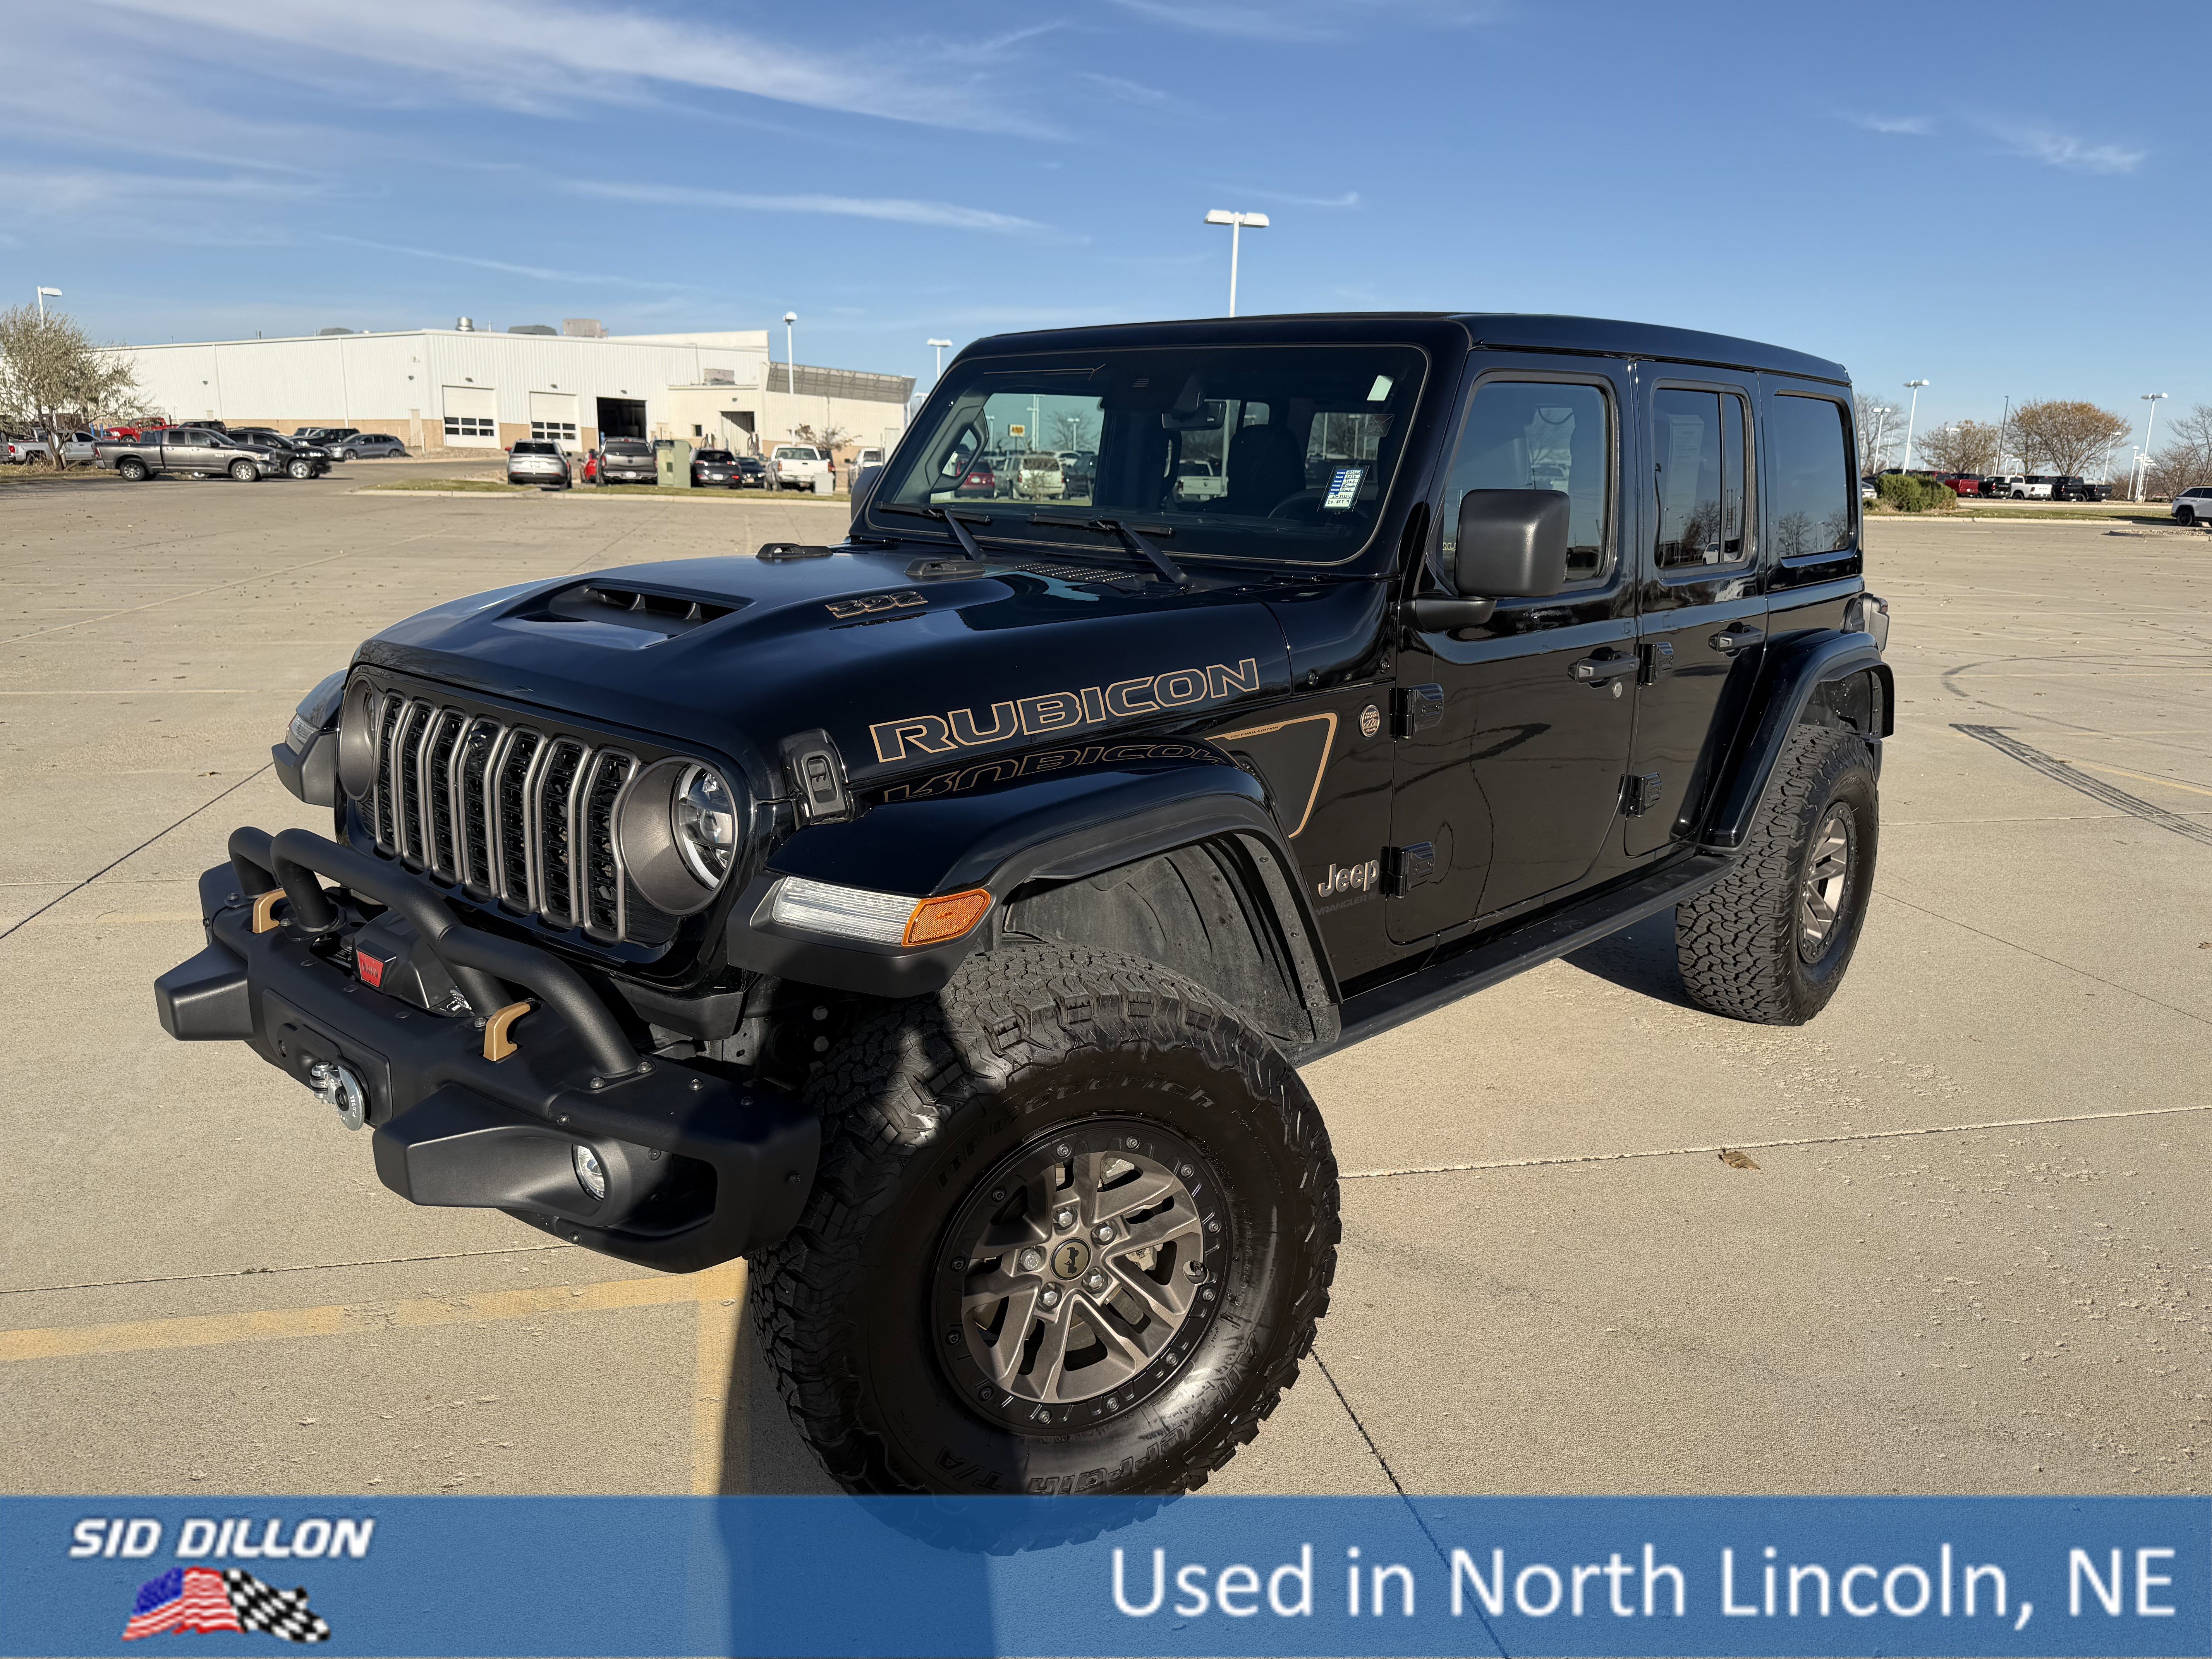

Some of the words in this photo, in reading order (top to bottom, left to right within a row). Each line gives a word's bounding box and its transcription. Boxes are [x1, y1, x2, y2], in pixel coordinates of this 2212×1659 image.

[825, 591, 928, 619] 392
[869, 657, 1260, 763] RUBICON
[1318, 859, 1380, 898] Jeep
